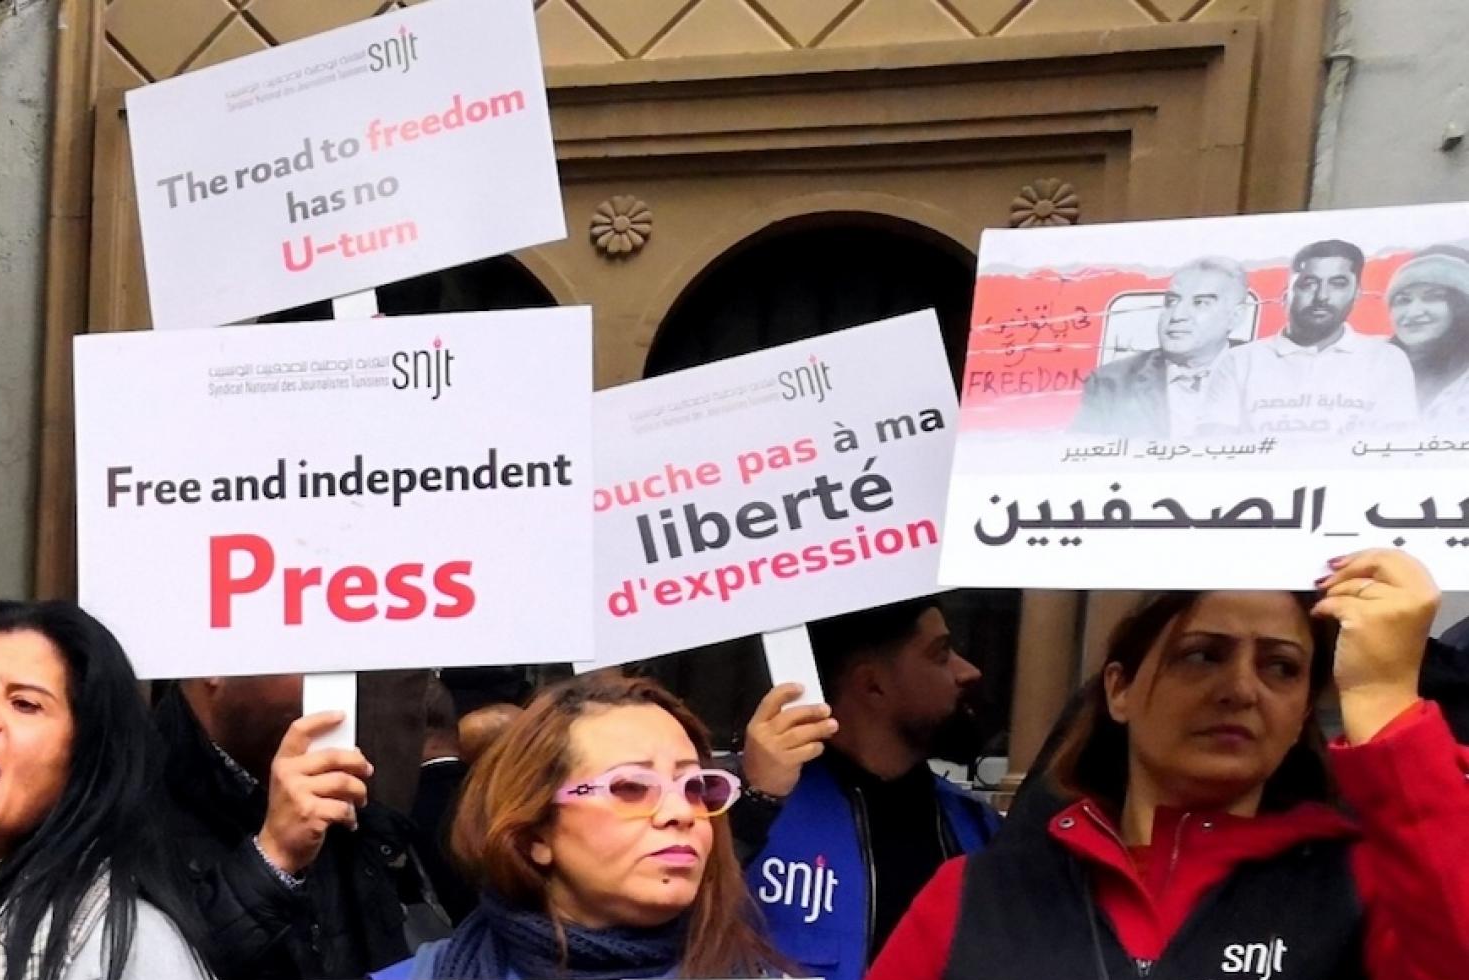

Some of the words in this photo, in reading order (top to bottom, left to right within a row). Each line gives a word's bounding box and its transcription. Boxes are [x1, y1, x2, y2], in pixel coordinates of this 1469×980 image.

[157, 171, 228, 209] The
[235, 138, 314, 190] road
[320, 135, 360, 165] to
[366, 89, 525, 152] freedom
[287, 189, 345, 223] has
[354, 175, 399, 206] no
[282, 219, 419, 274] U-turn
[392, 336, 455, 400] snjt
[107, 465, 201, 507] Free
[212, 458, 287, 501] and
[298, 448, 572, 507] independent
[593, 460, 723, 512] ouche
[737, 436, 818, 483] pas
[833, 421, 859, 453] à
[875, 407, 945, 443] ma
[636, 457, 894, 564] liberté
[973, 481, 1469, 547] يب_الصحفيين
[209, 532, 476, 629] Press
[607, 519, 939, 618] d'expression
[759, 855, 839, 923] snjt
